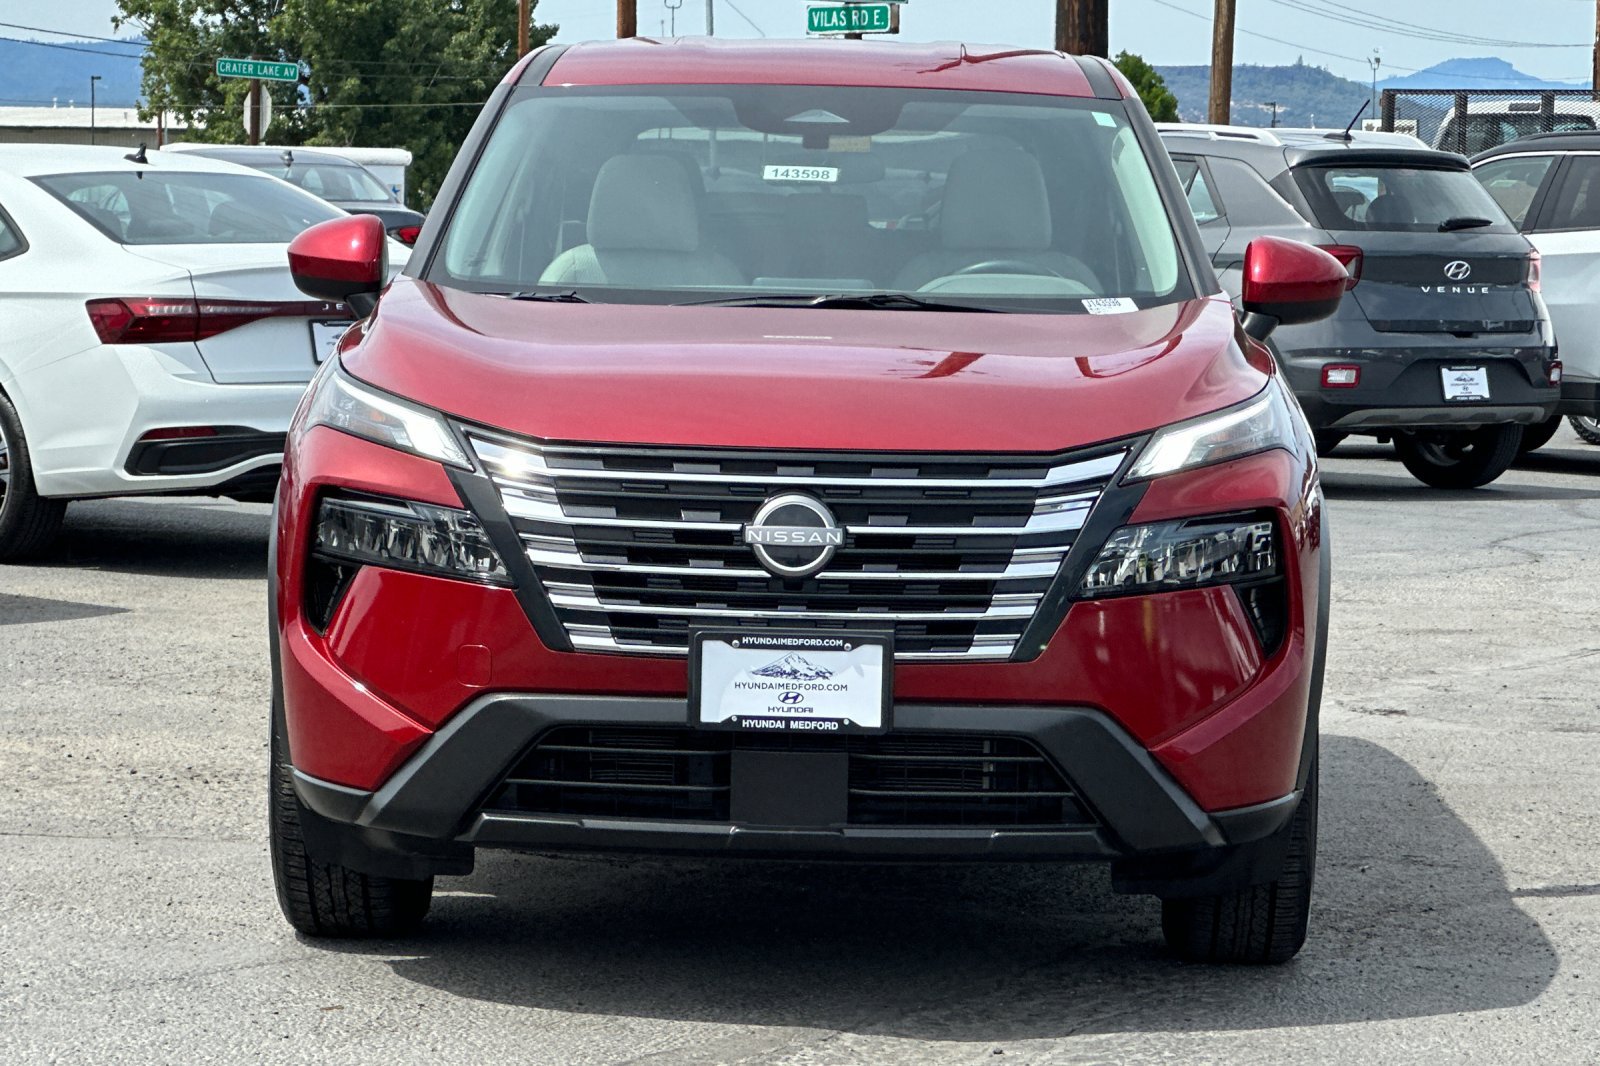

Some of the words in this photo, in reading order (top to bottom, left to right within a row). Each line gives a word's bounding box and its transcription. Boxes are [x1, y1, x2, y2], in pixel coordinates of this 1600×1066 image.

[812, 10, 847, 27] VILAS
[851, 9, 869, 26] RD
[873, 9, 884, 26] E.
[219, 61, 254, 75] CRATER
[257, 65, 280, 77] LAKE
[283, 67, 295, 77] AV
[771, 168, 830, 180] 143598
[1420, 286, 1489, 294] VENUE
[748, 530, 841, 544] NISSAN
[742, 636, 843, 647] HYUNDAIMEDFORD.COM
[734, 681, 848, 692] HYUNDAIMEDFORD.COM
[767, 706, 814, 714] HYUNDAI
[742, 719, 785, 729] HYUNDAI
[790, 720, 839, 730] MEDFORD
